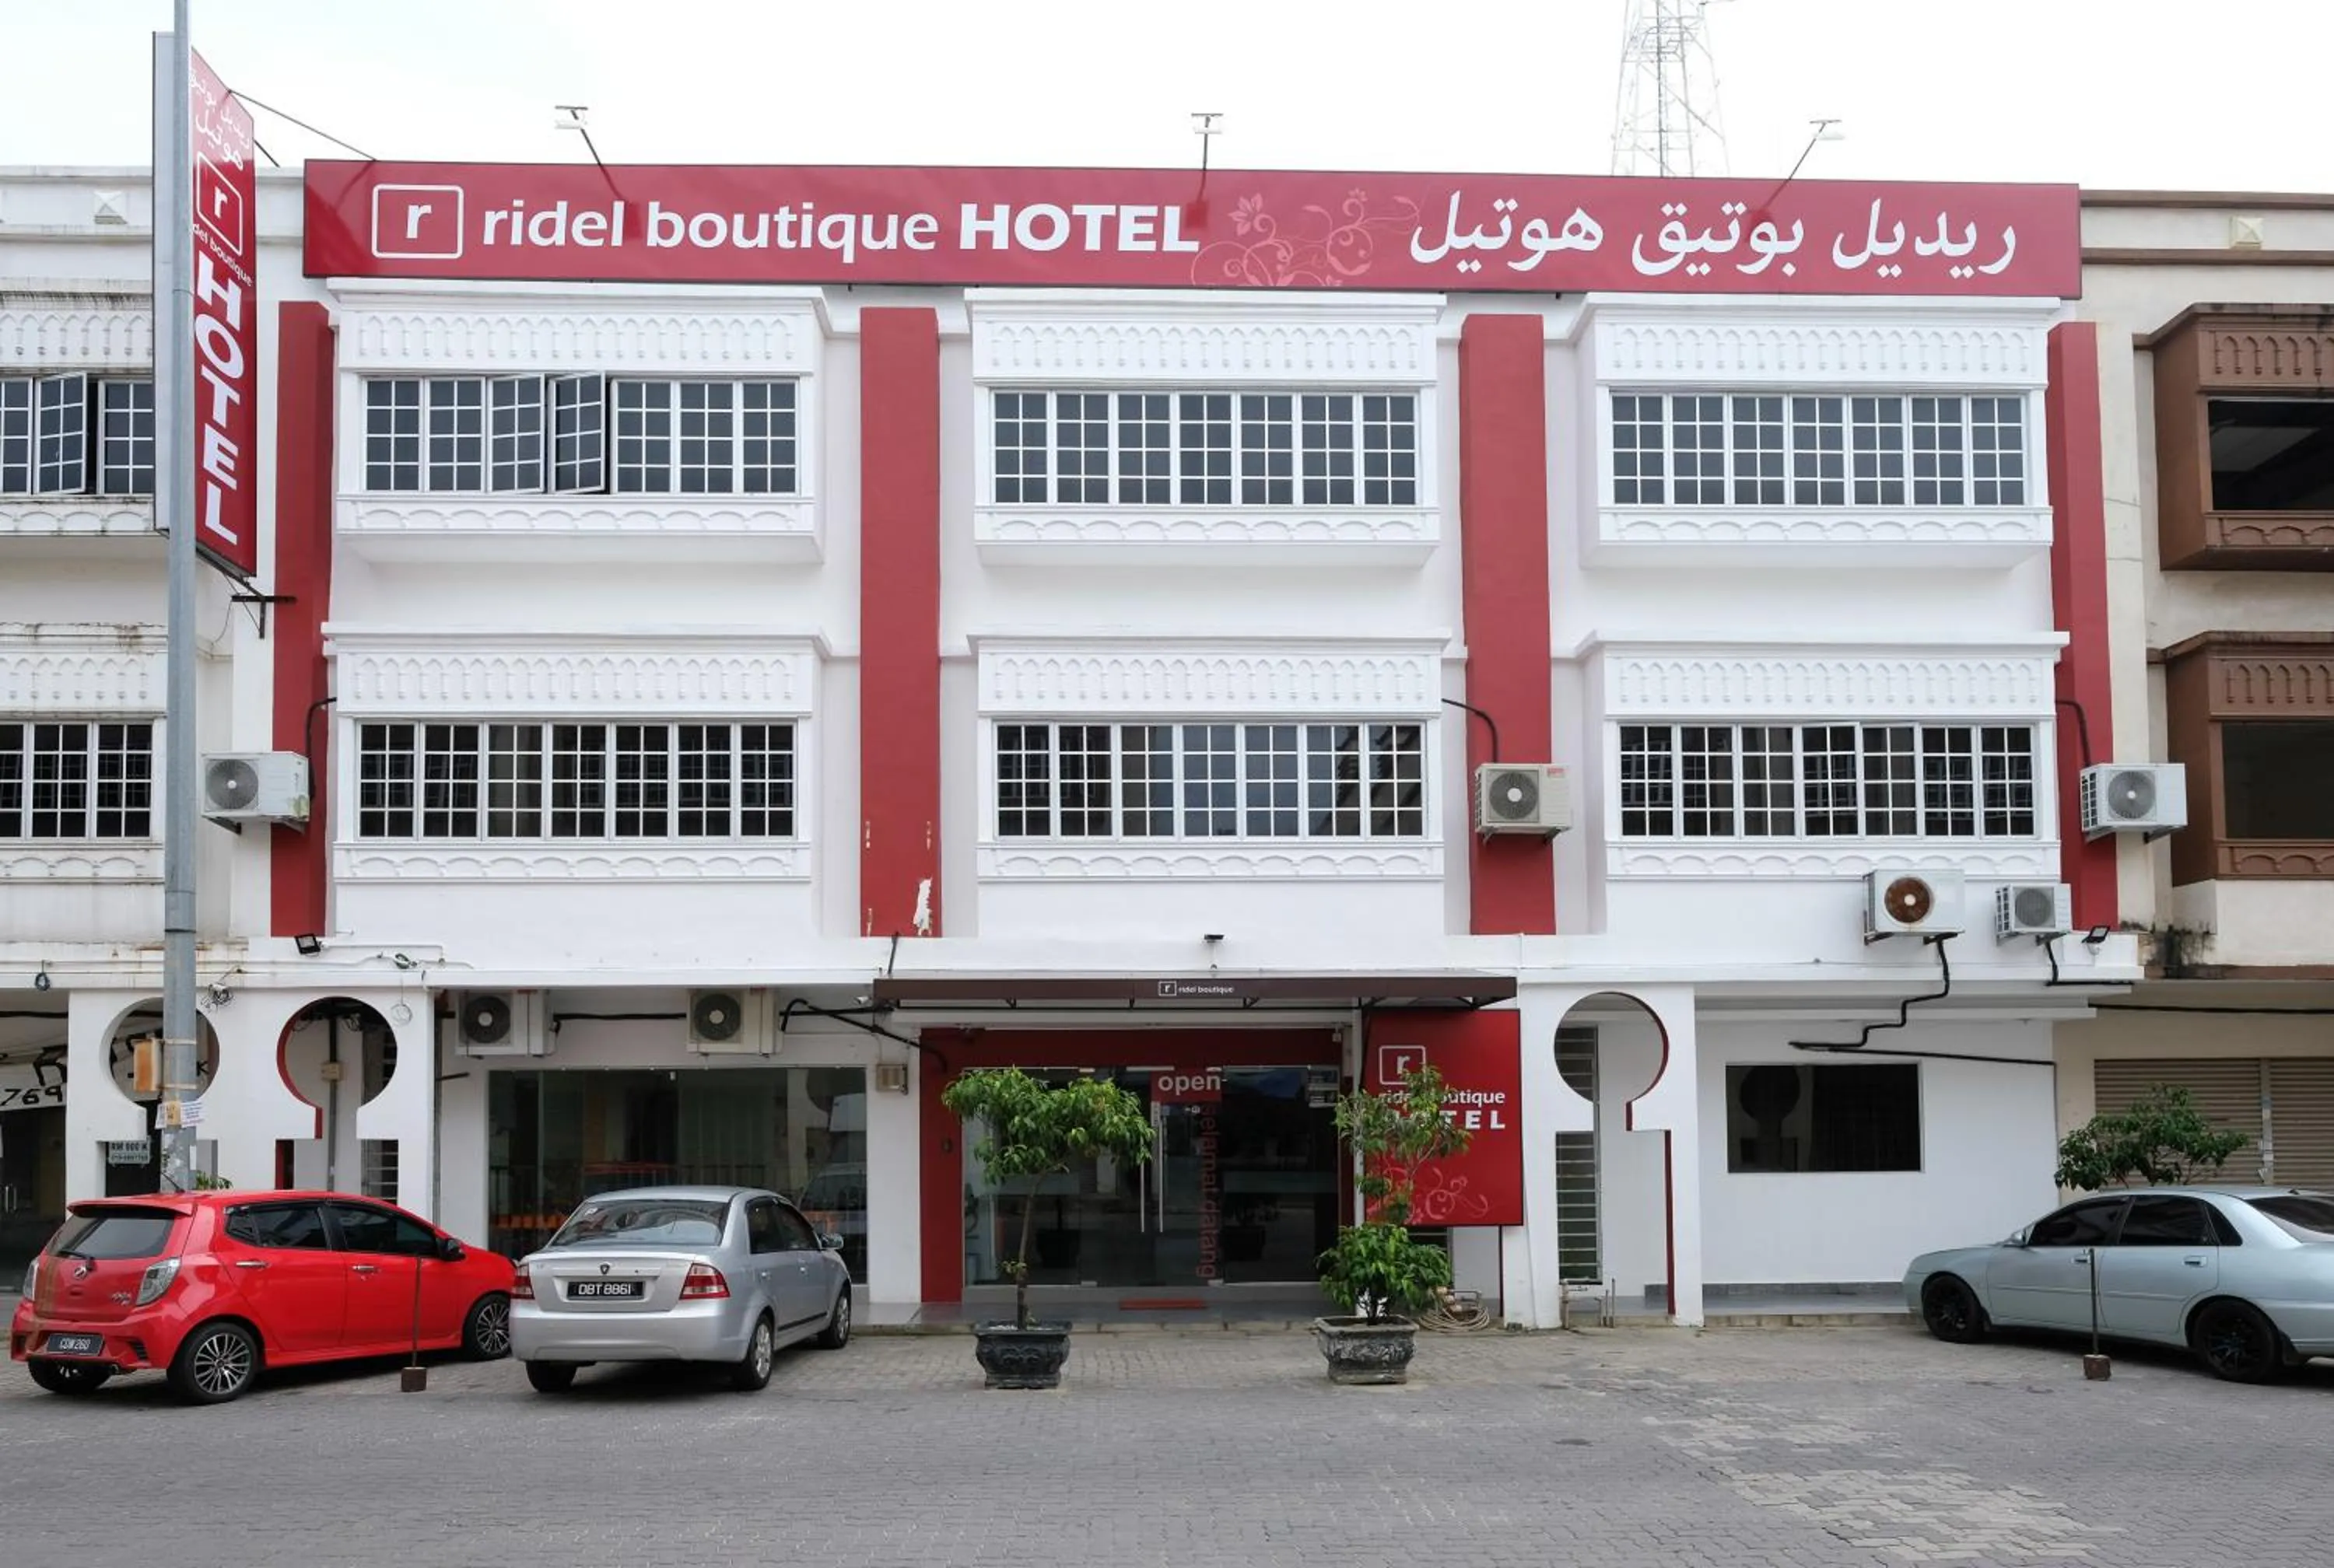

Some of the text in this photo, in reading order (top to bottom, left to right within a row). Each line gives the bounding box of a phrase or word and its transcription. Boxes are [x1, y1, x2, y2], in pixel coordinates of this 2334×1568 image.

[214, 186, 229, 219] r
[406, 205, 432, 239] r
[483, 199, 1200, 264] ridel boutique HOTEL
[1411, 191, 2016, 278] ريديل بوتيق هوتيل
[209, 236, 254, 287] boutique
[195, 250, 244, 544] HOTEL
[1198, 985, 1234, 995] boutique
[1397, 1055, 1411, 1074] r
[1158, 1076, 1221, 1096] open
[1378, 1089, 1505, 1108] ride utique
[1197, 1105, 1220, 1278] selamat datang
[578, 1283, 631, 1295] DBT 8861
